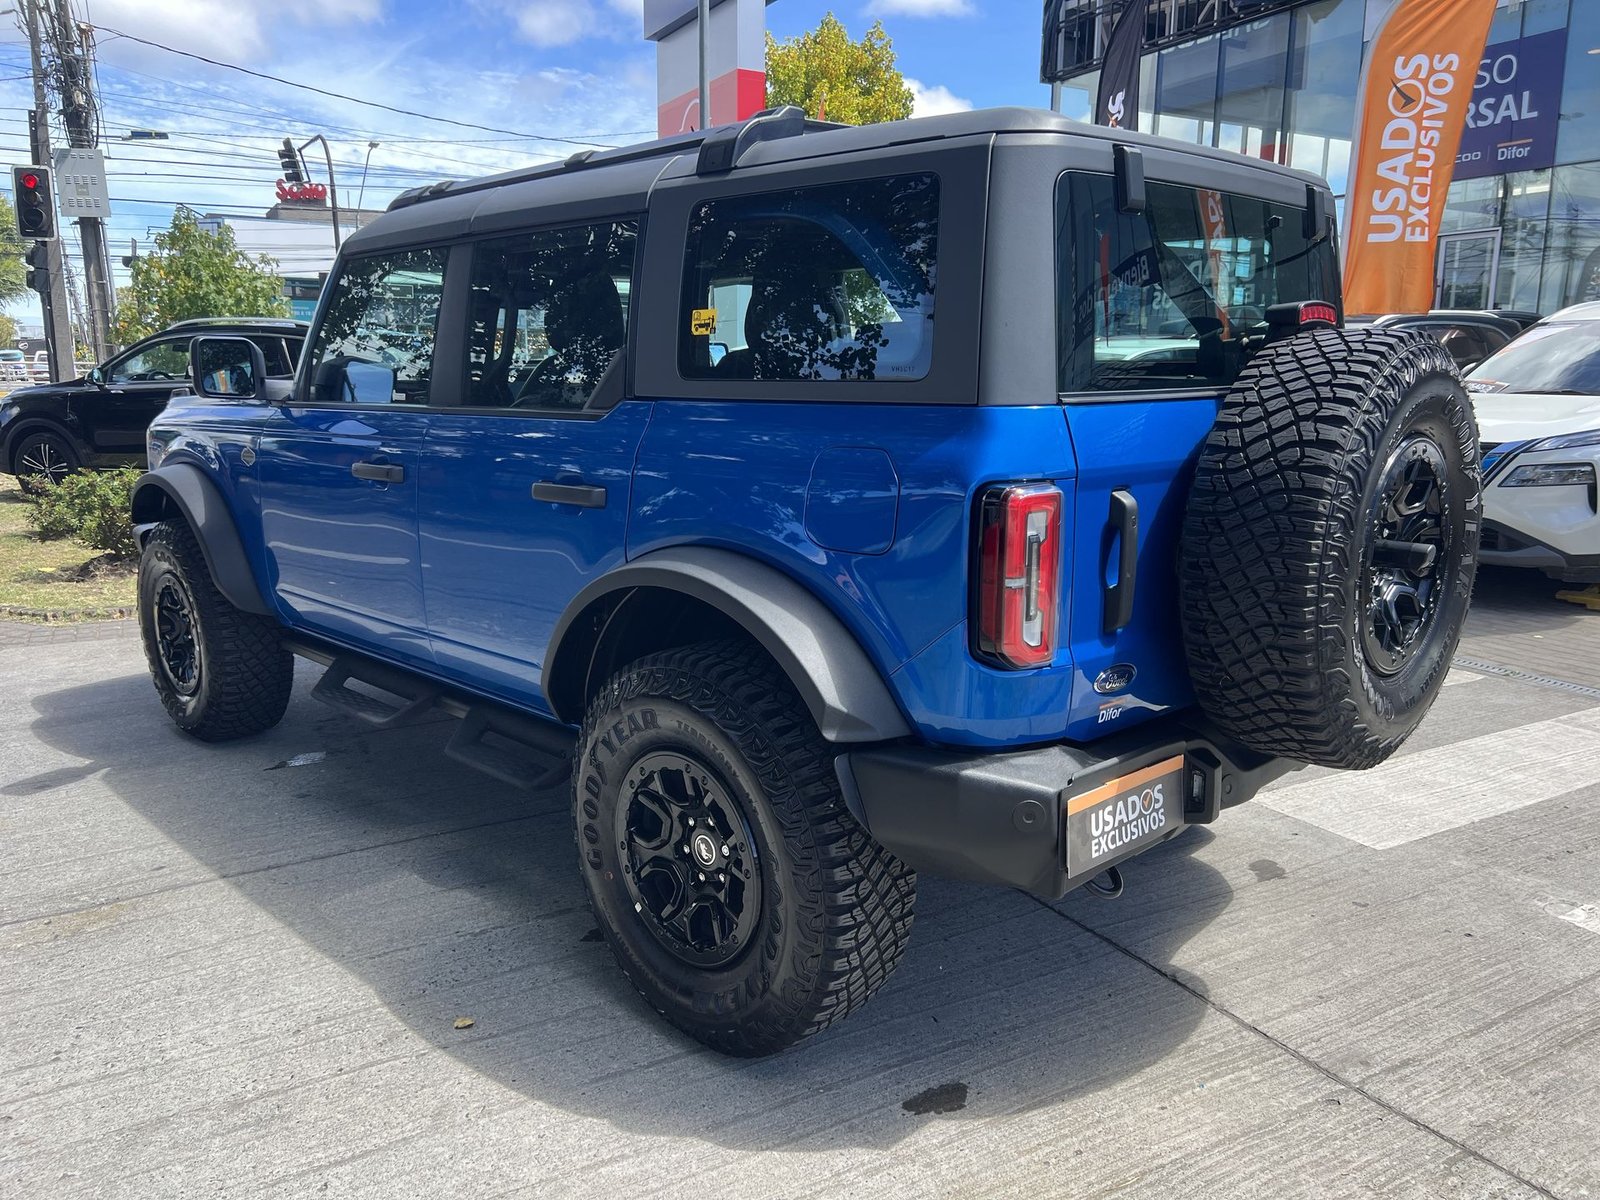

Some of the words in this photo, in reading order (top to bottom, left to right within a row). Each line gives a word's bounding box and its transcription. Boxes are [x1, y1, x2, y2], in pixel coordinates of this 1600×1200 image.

[1474, 54, 1518, 89] SO
[1465, 91, 1538, 128] RSAL
[1367, 53, 1430, 243] USADOS
[1404, 53, 1460, 242] EXCLUSIVOS
[1497, 146, 1531, 161] Difor
[1097, 706, 1123, 724] Difor
[582, 707, 662, 871] GOODYEAR
[1090, 783, 1164, 838] USADOS
[1091, 808, 1166, 859] EXCLUSIVOS
